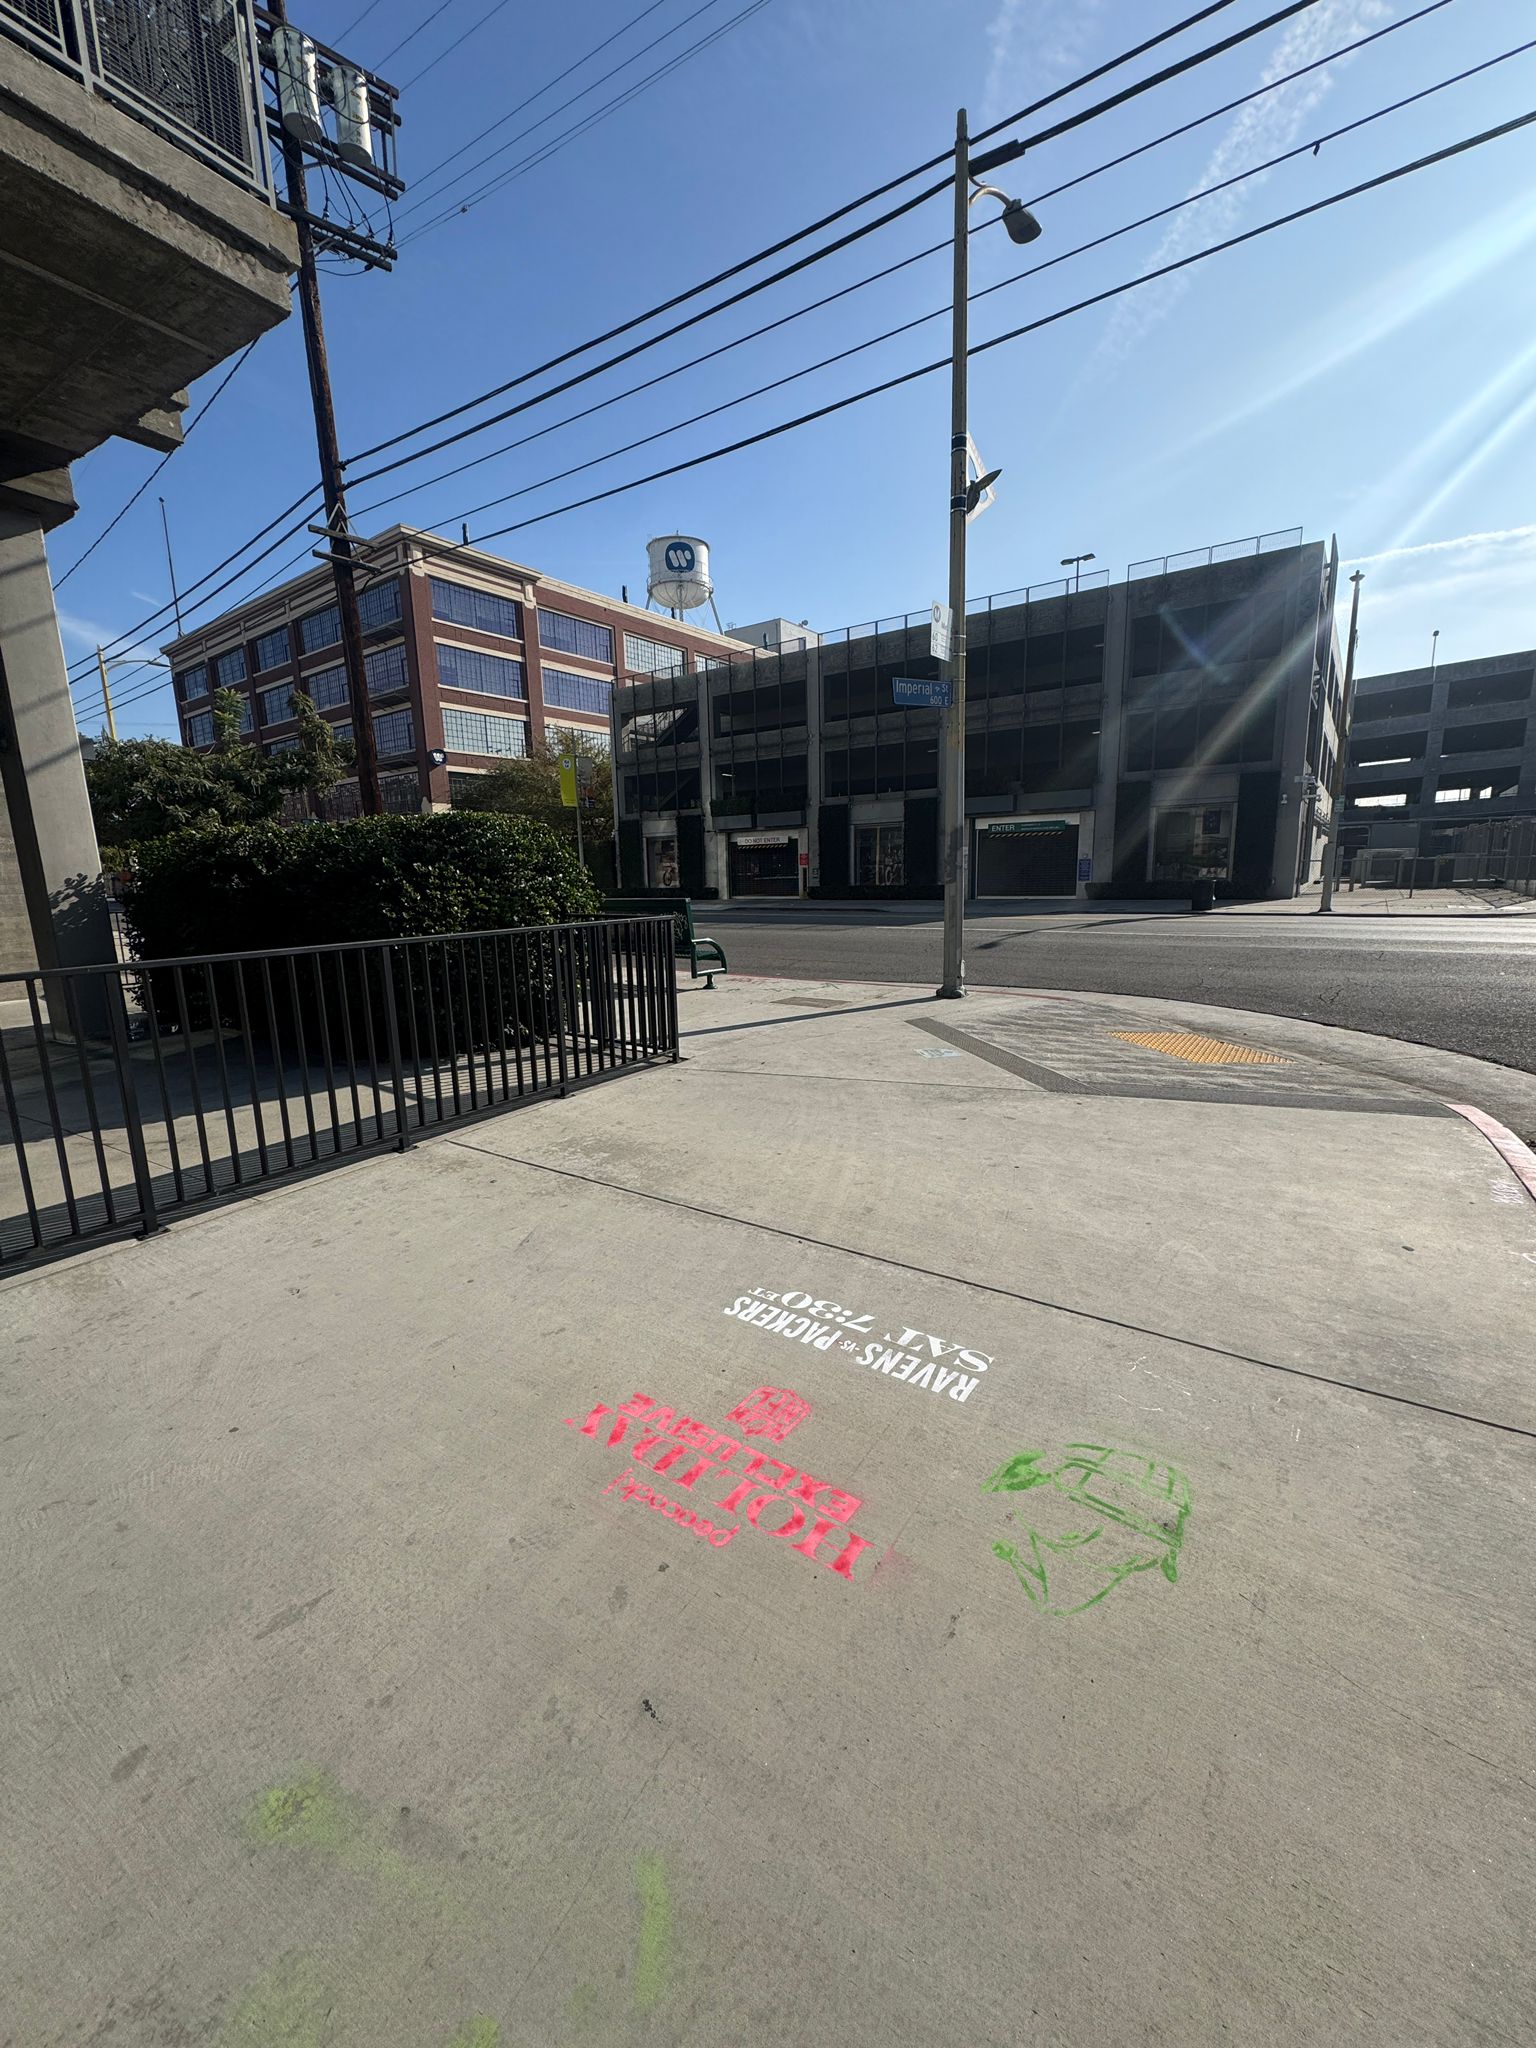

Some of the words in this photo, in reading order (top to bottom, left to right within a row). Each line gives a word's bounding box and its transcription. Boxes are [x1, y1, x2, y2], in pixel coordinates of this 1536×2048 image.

[895, 679, 933, 696] Imperial
[941, 683, 949, 693] St
[929, 695, 943, 705] 600
[944, 696, 949, 706] E
[991, 824, 1015, 832] ENTER
[723, 1296, 843, 1351] PACKERS
[856, 1341, 980, 1403] RAVENS
[883, 1326, 995, 1373] SAT
[617, 1392, 864, 1524] EXCLUSIVE
[561, 1402, 876, 1582] HOLIDAY
